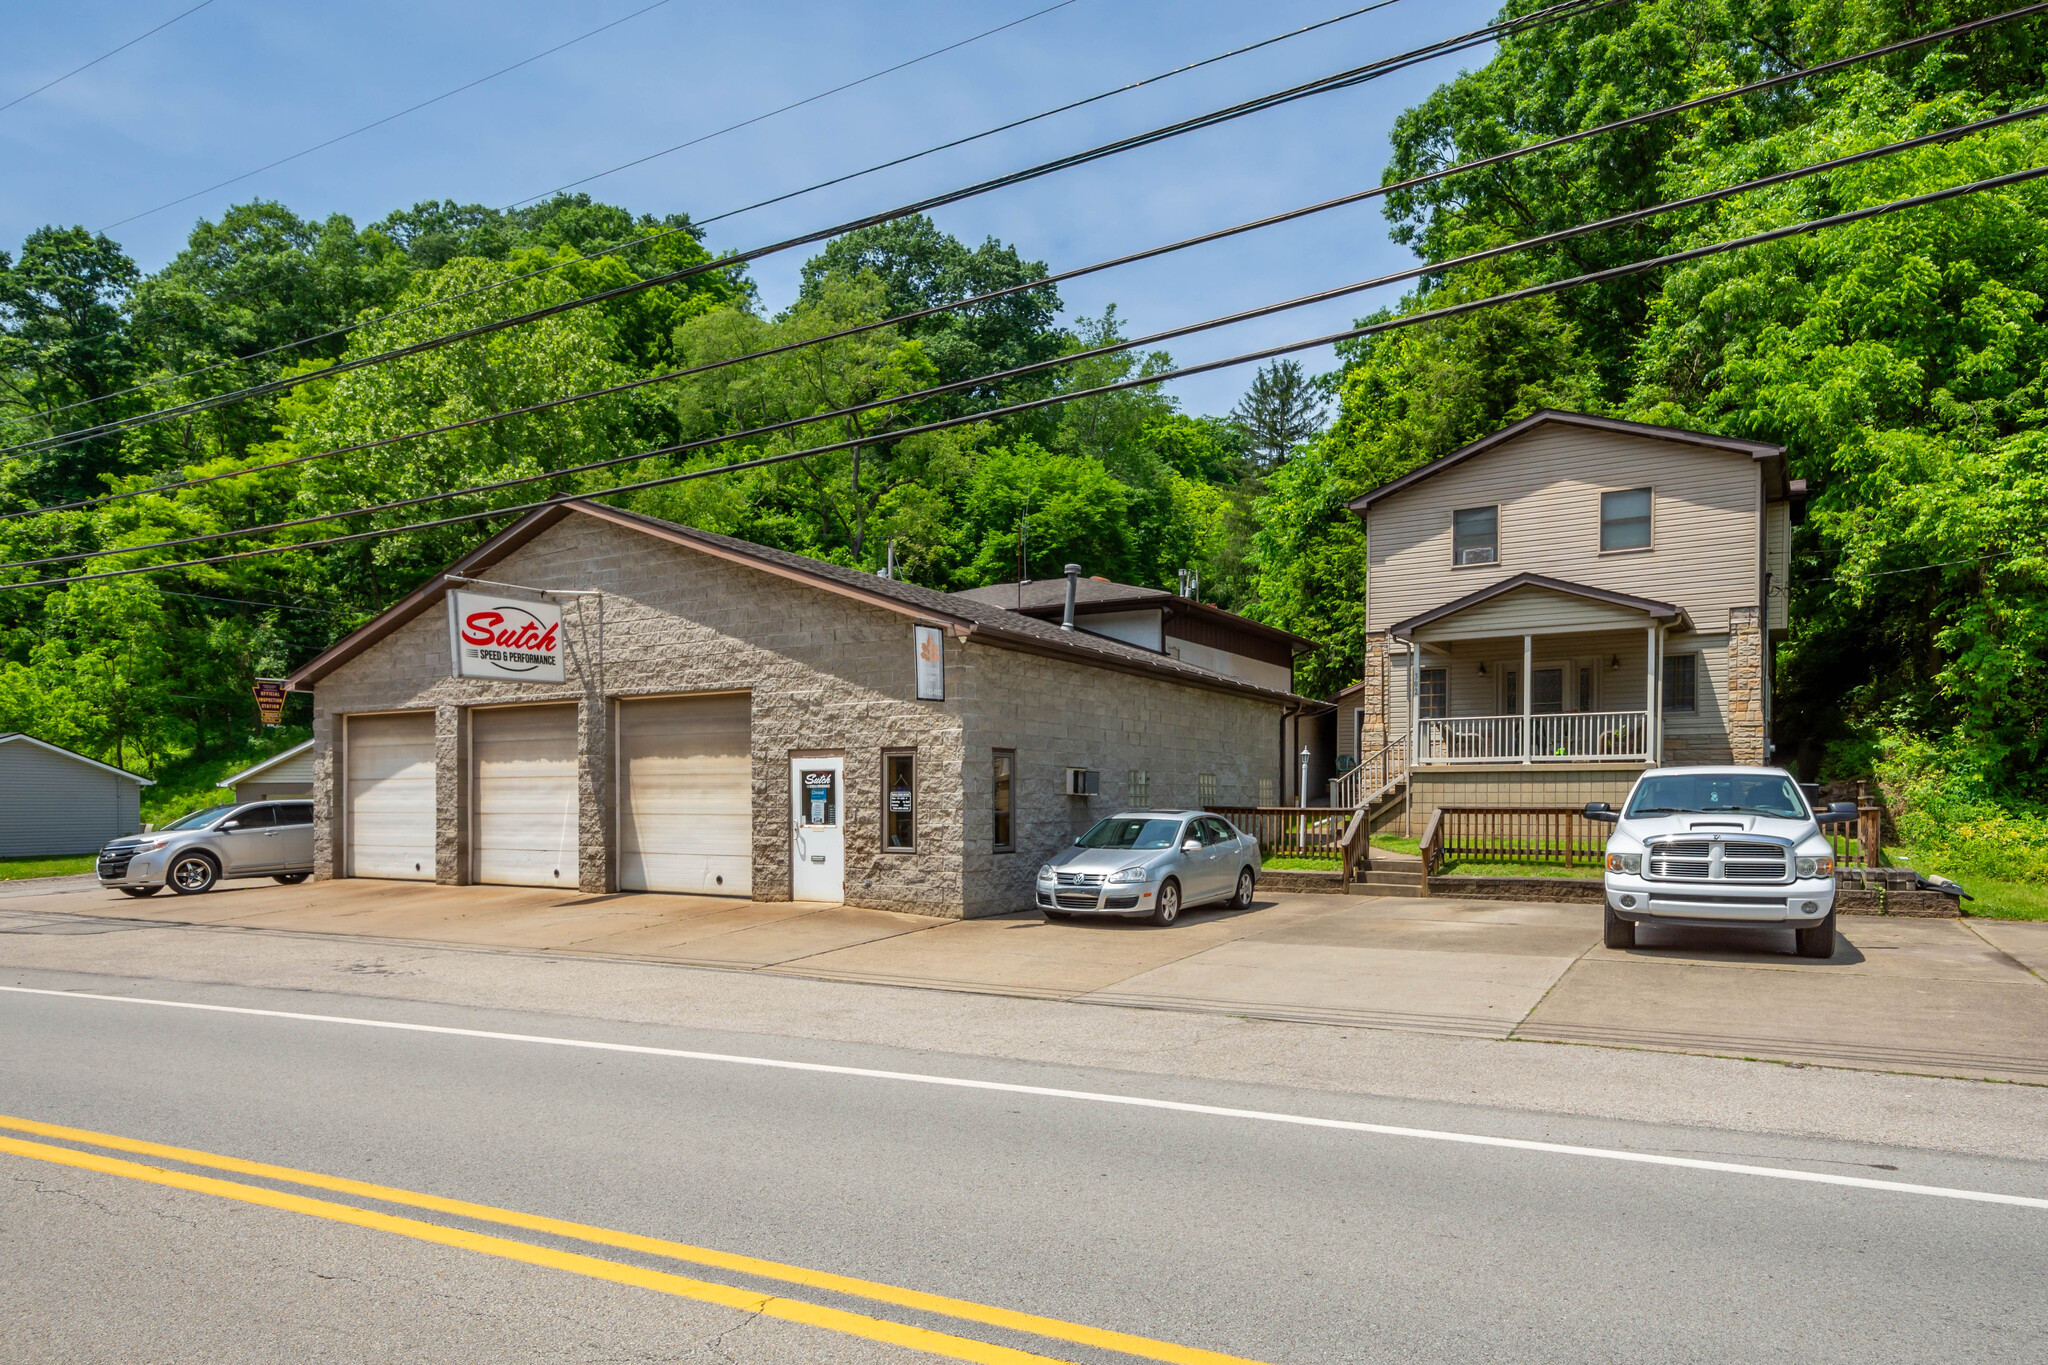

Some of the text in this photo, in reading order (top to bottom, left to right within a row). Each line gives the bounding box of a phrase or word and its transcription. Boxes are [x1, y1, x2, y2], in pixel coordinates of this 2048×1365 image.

[461, 611, 559, 652] Sutch
[480, 649, 556, 666] SPEED & PERFORMANCE
[804, 773, 832, 785] Sutch
